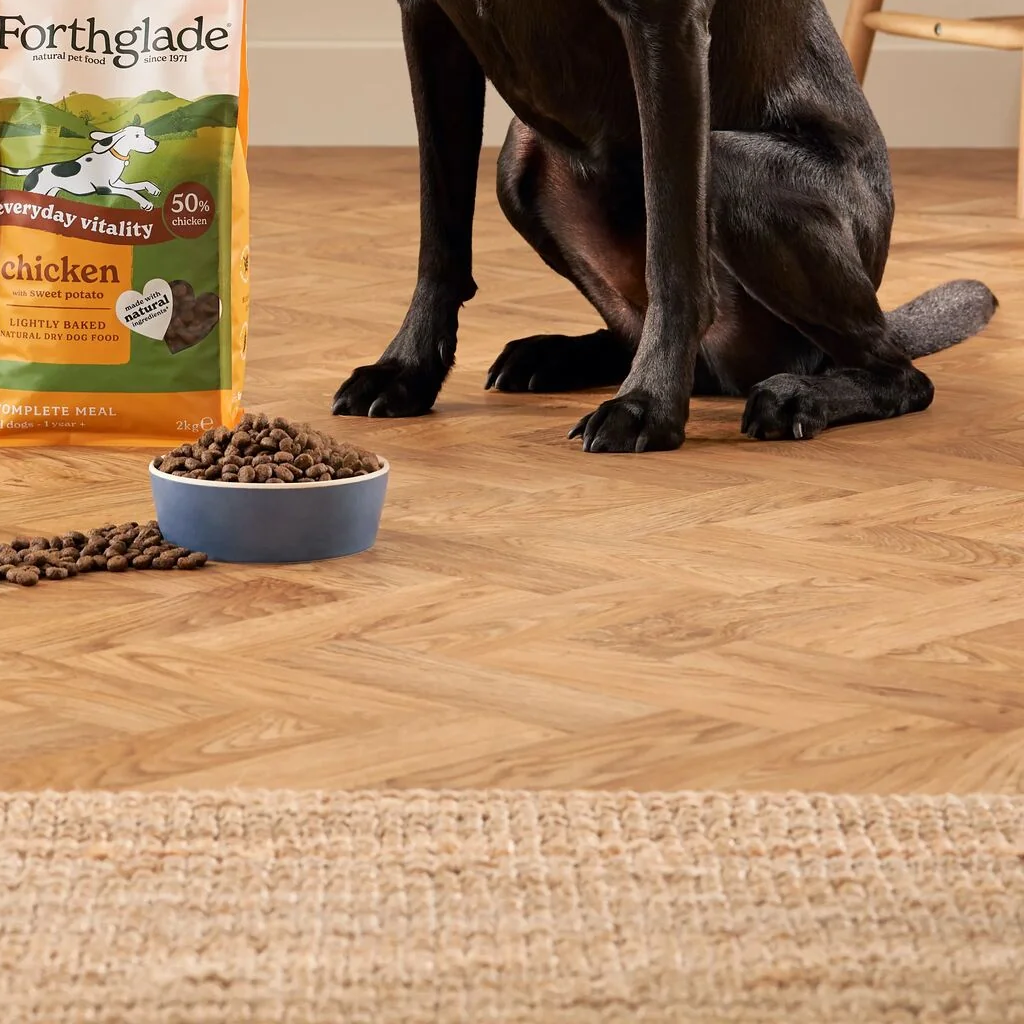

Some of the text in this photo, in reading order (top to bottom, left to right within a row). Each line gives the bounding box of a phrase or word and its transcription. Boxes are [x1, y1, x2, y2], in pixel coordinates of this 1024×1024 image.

[32, 52, 106, 65] natural pet food
[144, 54, 188, 64] since 1971
[171, 192, 210, 213] 50%
[172, 216, 207, 226] chicken
[80, 215, 153, 240] vitality
[0, 254, 120, 284] chicken
[29, 289, 63, 299] sweet
[65, 289, 104, 301] potato
[124, 290, 162, 312] made with
[123, 294, 170, 323] natural
[9, 318, 106, 330] LIGHTLY BAKED
[0, 330, 119, 342] NATURAL DRY DOG FOOD
[75, 406, 117, 416] MEAL
[6, 419, 34, 429] dogs
